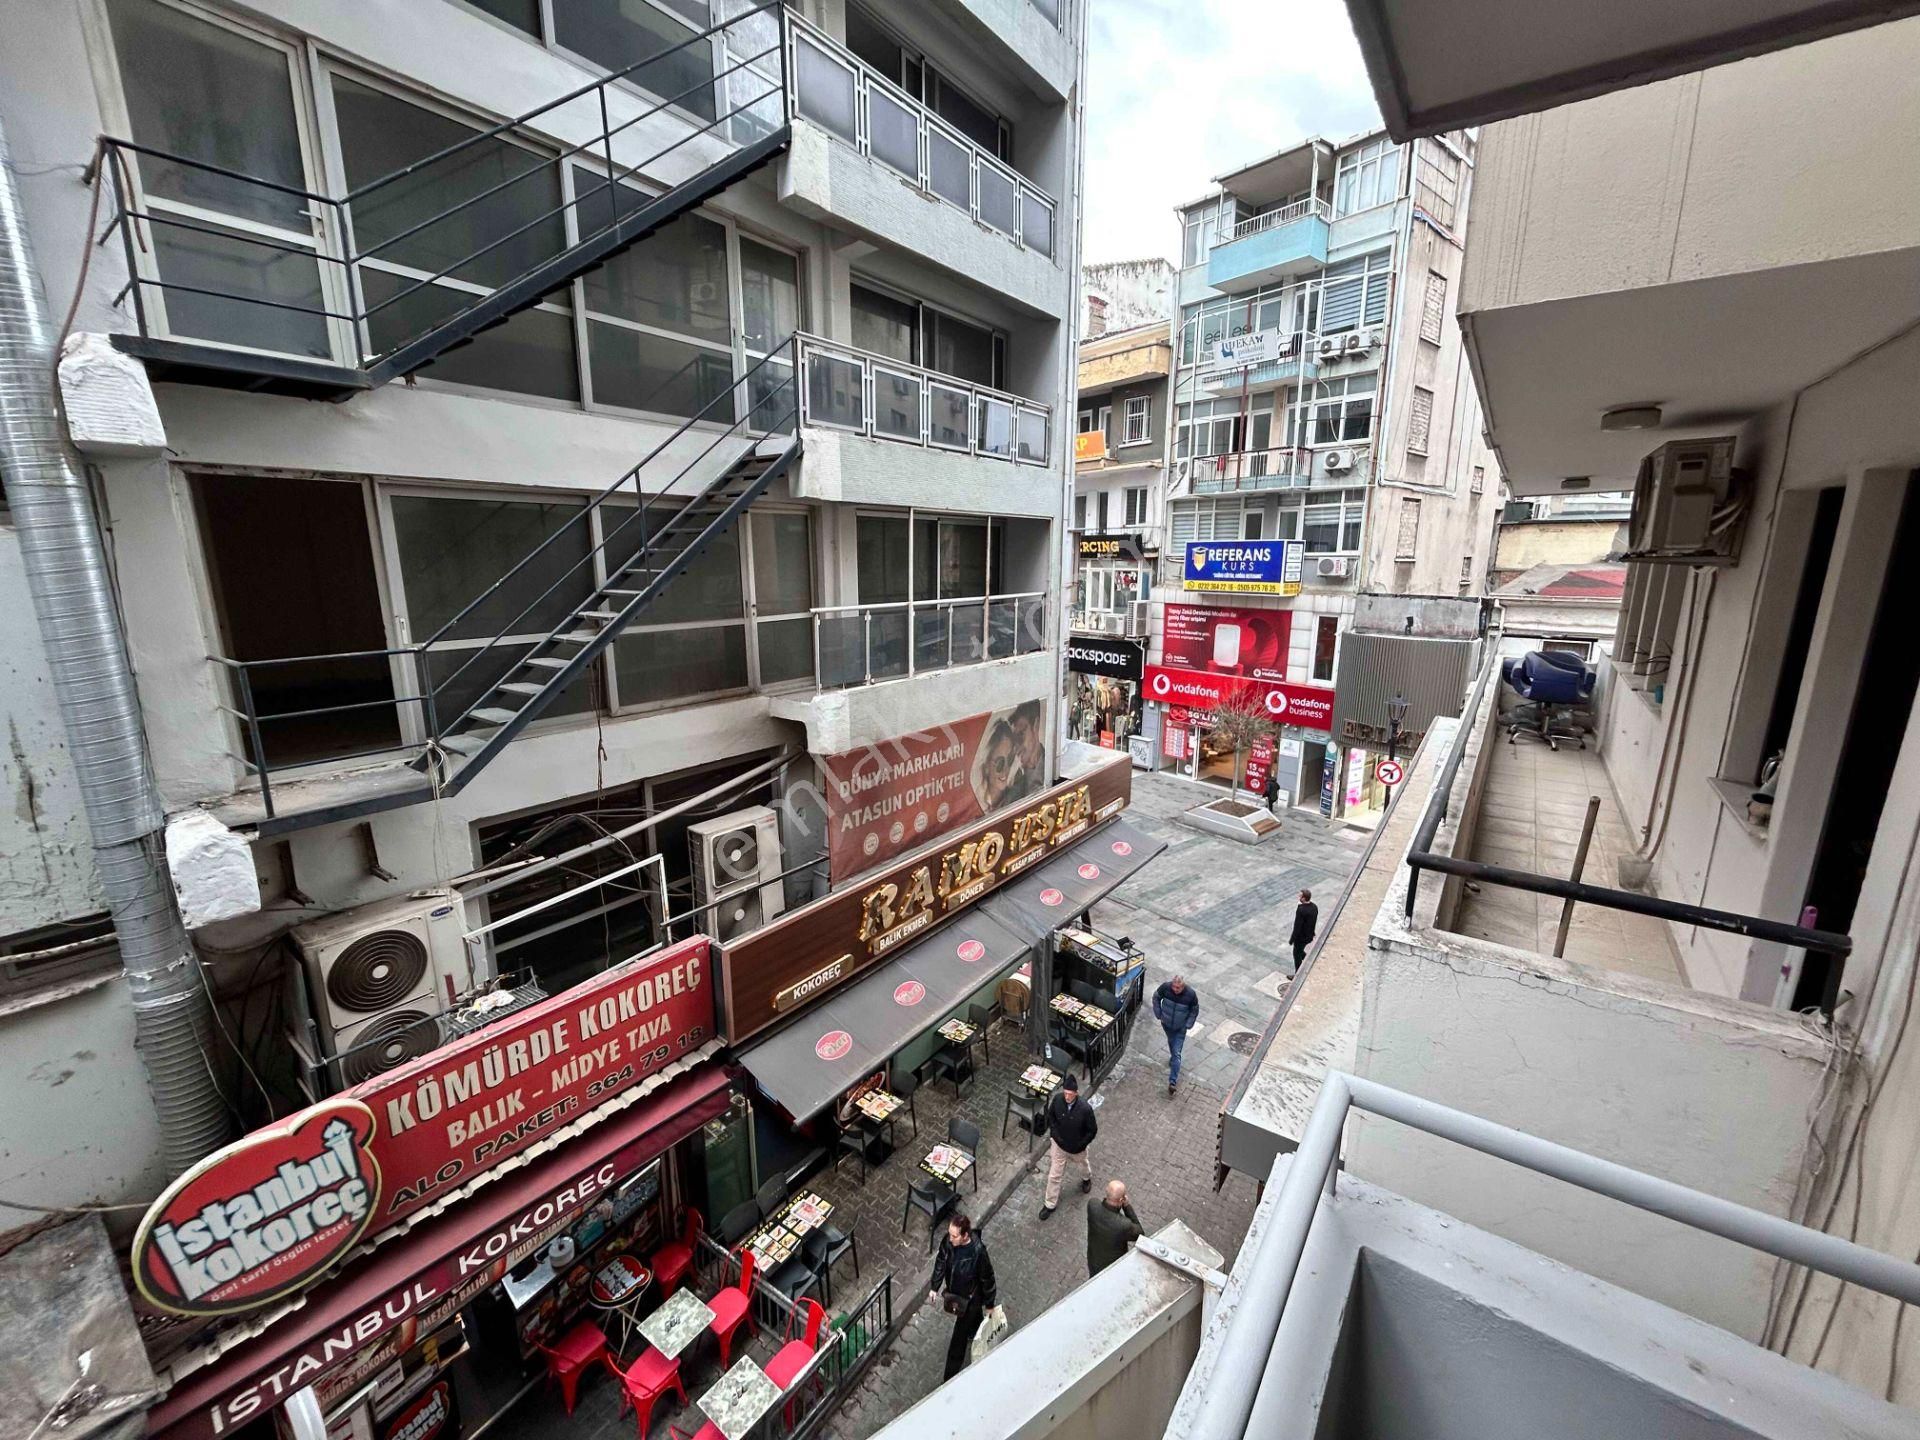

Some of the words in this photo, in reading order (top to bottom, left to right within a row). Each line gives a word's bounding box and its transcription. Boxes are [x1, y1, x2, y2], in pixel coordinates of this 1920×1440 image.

[1208, 548, 1271, 561] REFERANS
[1221, 562, 1255, 571] KURS
[1172, 682, 1220, 699] vodafone
[1289, 696, 1331, 711] vodafone
[1289, 705, 1323, 719] business
[839, 767, 891, 799] DÜNYA
[893, 743, 965, 780] MARKALARI
[841, 793, 902, 833] ATASUN
[905, 770, 965, 807] OPTİK'TE!
[858, 832, 1004, 942] RAMO
[1010, 785, 1092, 852] USTA
[959, 882, 985, 904] DÖNER
[879, 927, 902, 950] BALIK
[903, 914, 928, 937] EKMEK
[793, 964, 841, 1000] KOKOREÇ
[386, 1018, 568, 1137] KÖMÜRDE
[578, 957, 701, 1042] KOKOREÇ
[446, 1088, 525, 1149] BALIK
[551, 1039, 621, 1093] MİDYE
[626, 1013, 672, 1049] TAVA
[386, 1159, 464, 1215] ALO
[474, 1095, 579, 1165] PAKET:
[586, 1064, 634, 1100] 364
[640, 1045, 669, 1071] 79
[676, 1025, 704, 1049] 18
[153, 1118, 355, 1266] istanbul
[171, 1178, 368, 1301] kokoreç
[211, 1282, 239, 1302] özel
[242, 1264, 271, 1285] tarif
[274, 1242, 311, 1268] özgün
[314, 1221, 351, 1243] lezzet
[210, 1283, 436, 1435] İSTANBUL
[458, 1163, 615, 1275] KOKOREÇ
[422, 1297, 458, 1328] MEZGİT
[459, 1272, 489, 1304] BALIĞI
